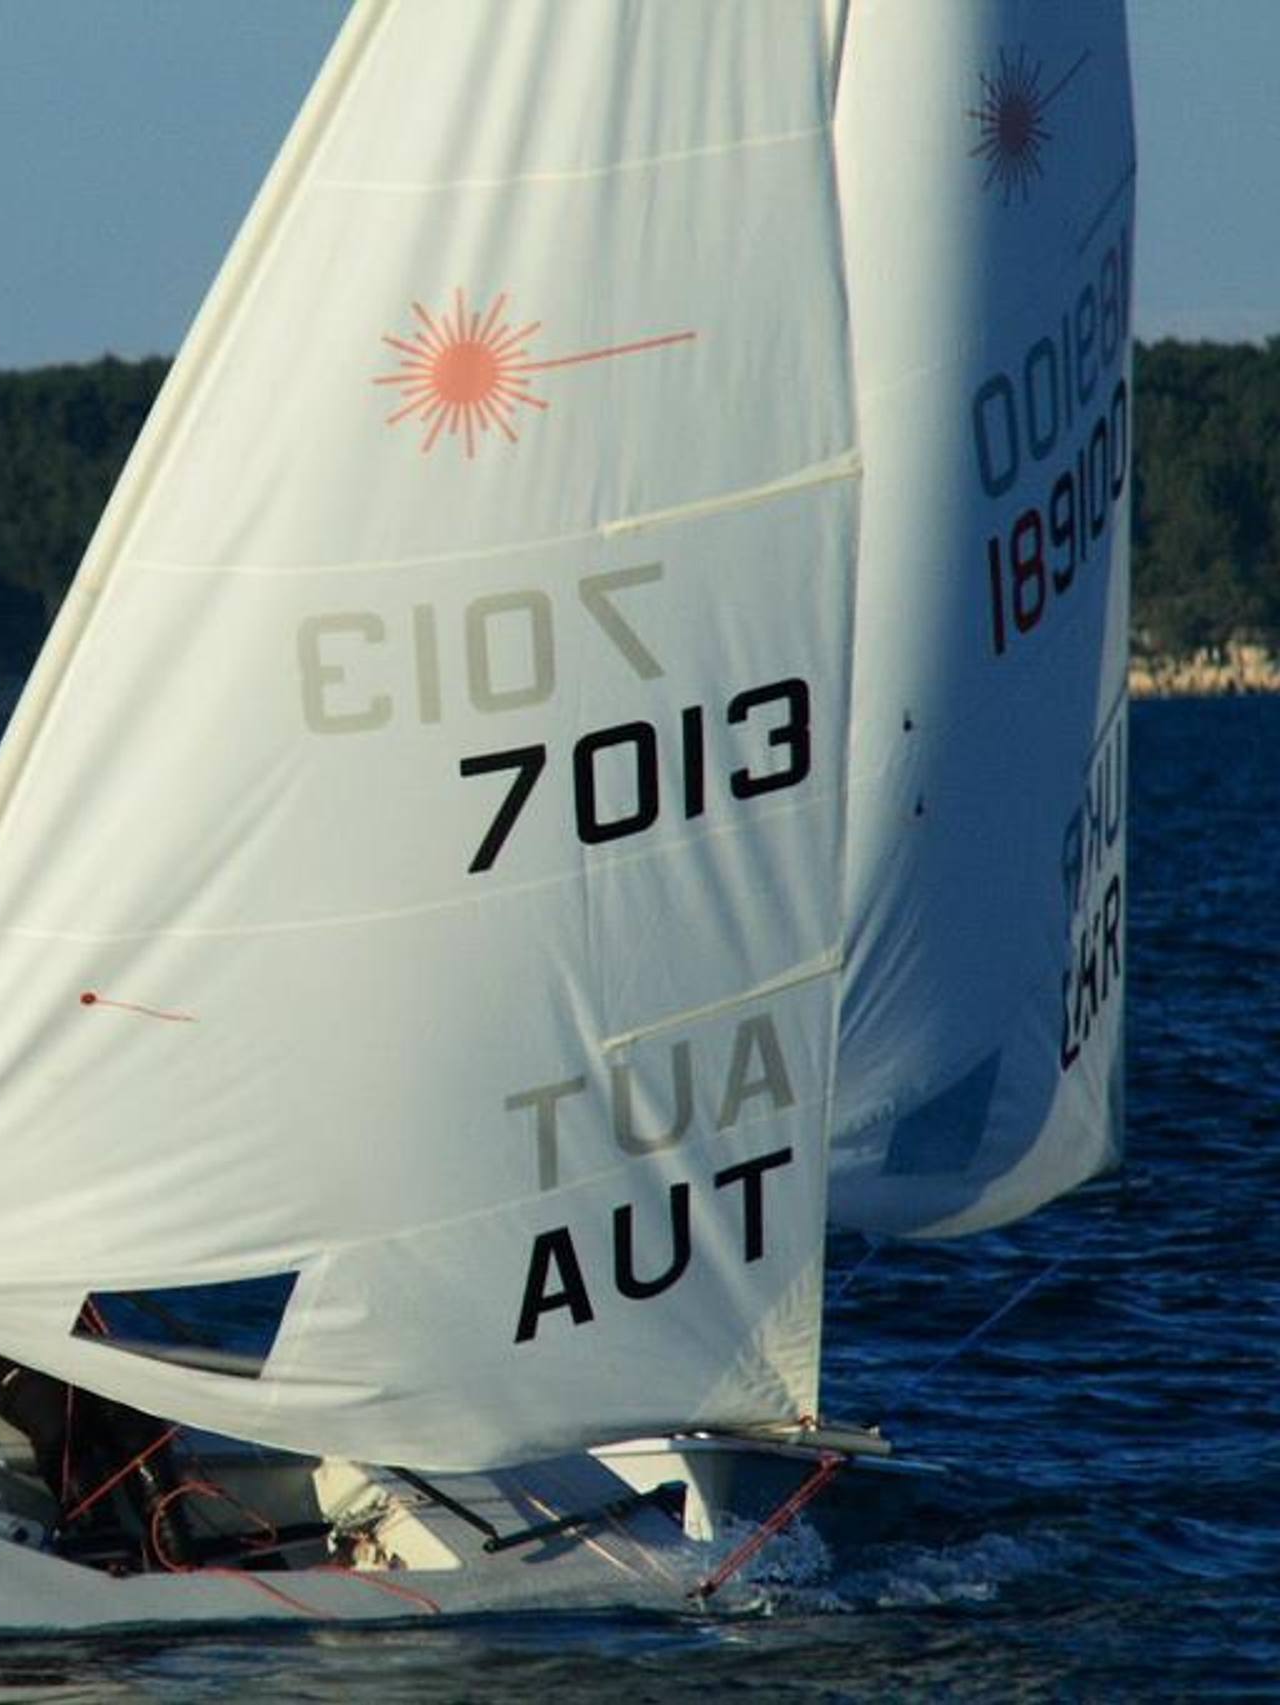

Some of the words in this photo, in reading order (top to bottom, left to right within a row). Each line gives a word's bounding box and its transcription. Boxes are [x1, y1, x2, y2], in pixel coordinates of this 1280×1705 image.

[988, 376, 1126, 656] 189100
[459, 677, 811, 874] 7013
[514, 1146, 793, 1344] AUT
